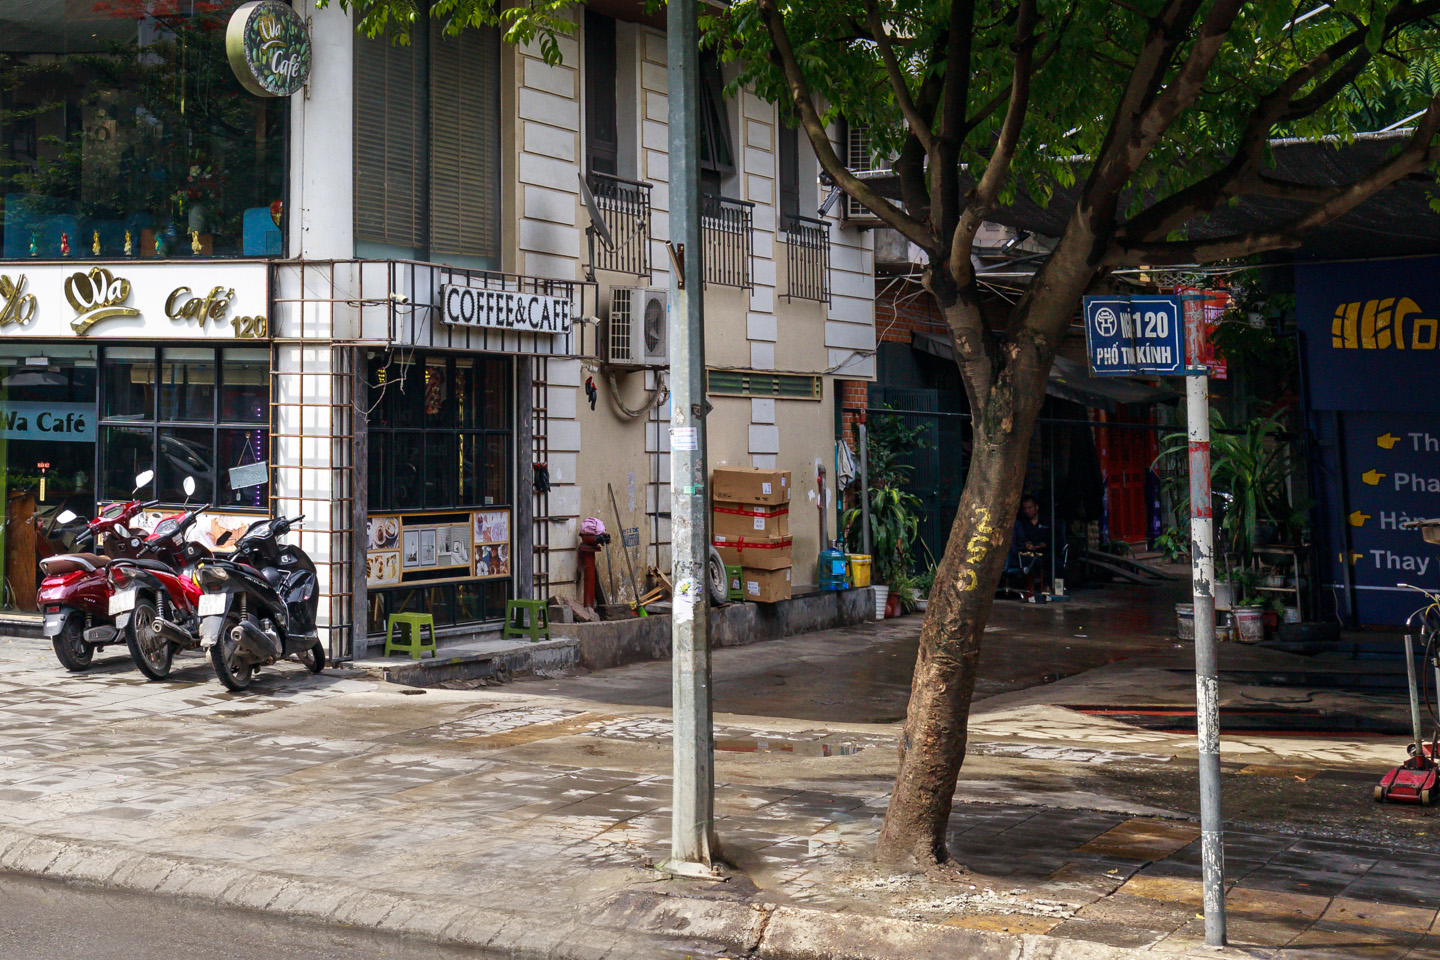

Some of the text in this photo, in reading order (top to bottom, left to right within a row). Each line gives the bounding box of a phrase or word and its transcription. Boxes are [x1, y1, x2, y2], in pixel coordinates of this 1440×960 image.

[261, 18, 281, 40] Wa
[271, 50, 300, 83] Café
[165, 286, 235, 328] Café
[447, 287, 570, 331] COFFEE&CAFE
[231, 315, 266, 338] 120
[1133, 311, 1169, 338] 120
[1096, 342, 1119, 365] PHỐ
[1136, 343, 1171, 364] KÍNH
[37, 411, 86, 433] Café
[1370, 549, 1430, 576] Thay
